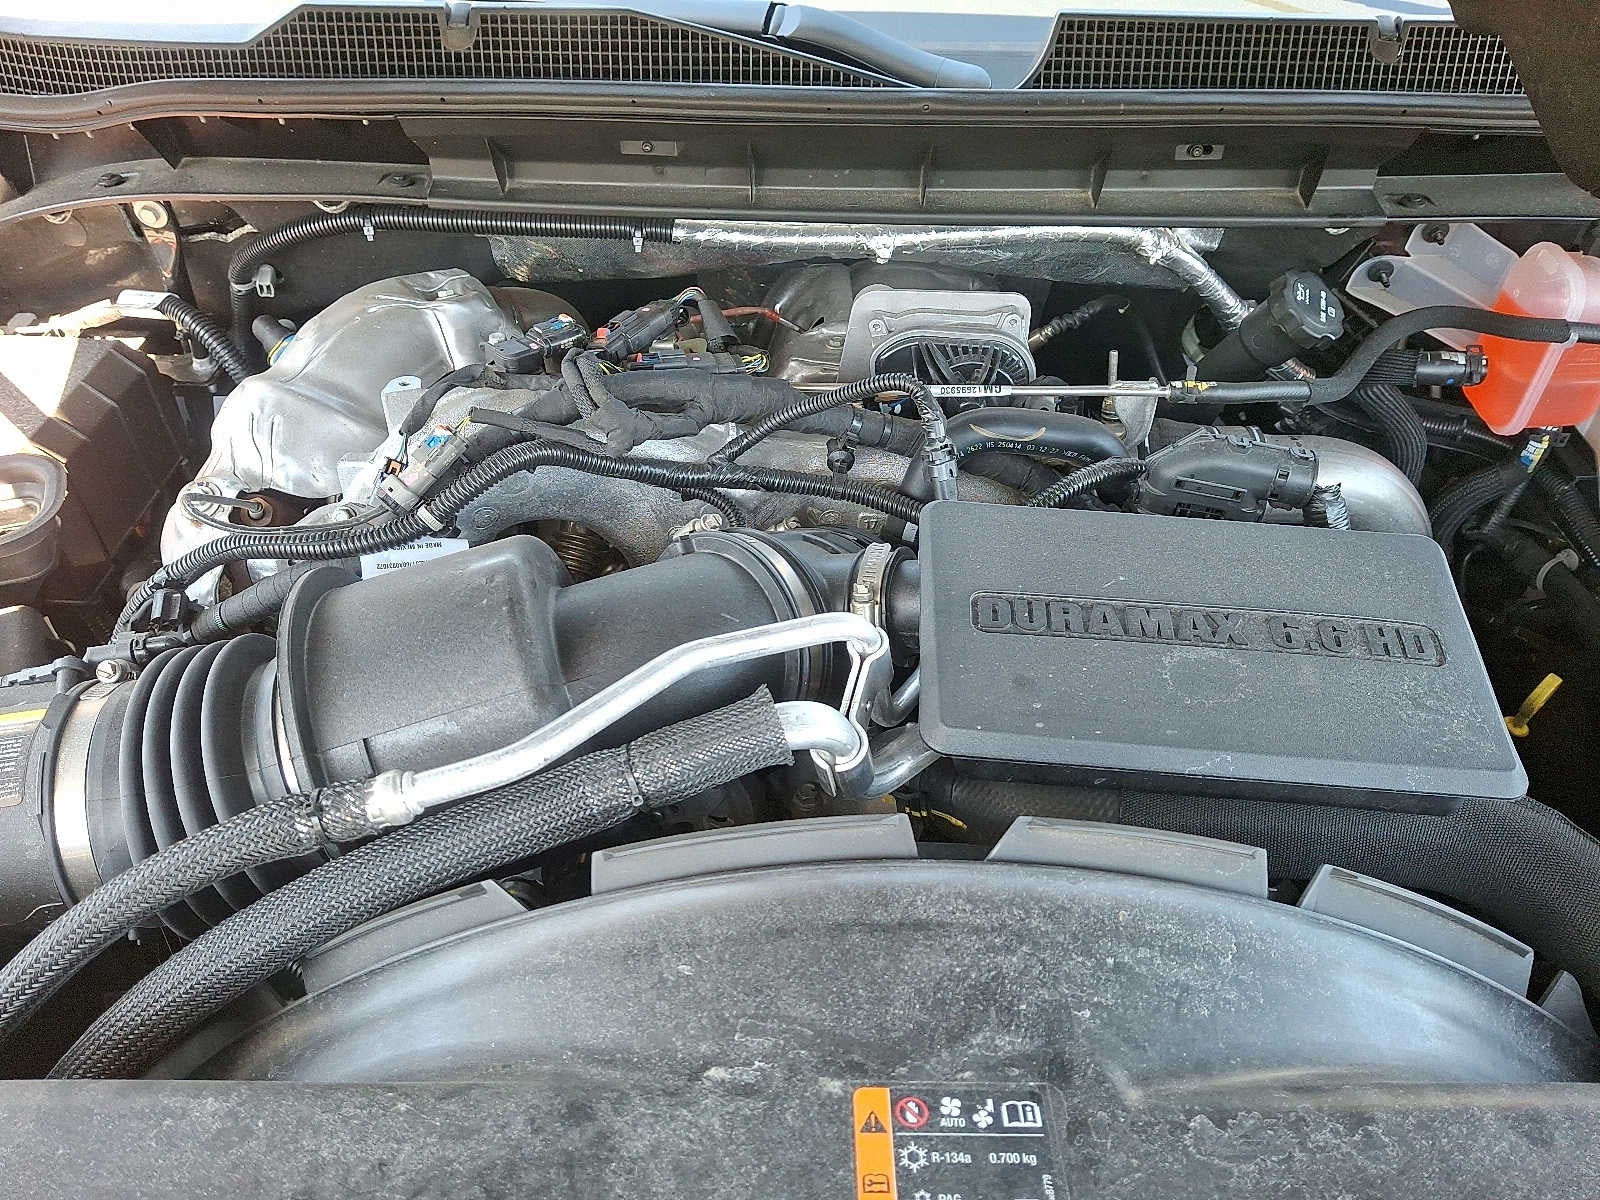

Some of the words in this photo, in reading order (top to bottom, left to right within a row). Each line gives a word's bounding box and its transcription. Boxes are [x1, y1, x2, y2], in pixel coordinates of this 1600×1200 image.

[979, 597, 1249, 646] DURAMAX
[1268, 615, 1351, 652] 6.6
[1357, 622, 1438, 661] HD
[940, 1118, 966, 1127] AUTO
[931, 1153, 972, 1164] R-134a
[989, 1153, 1020, 1164] 0.700
[1022, 1153, 1037, 1166] kg
